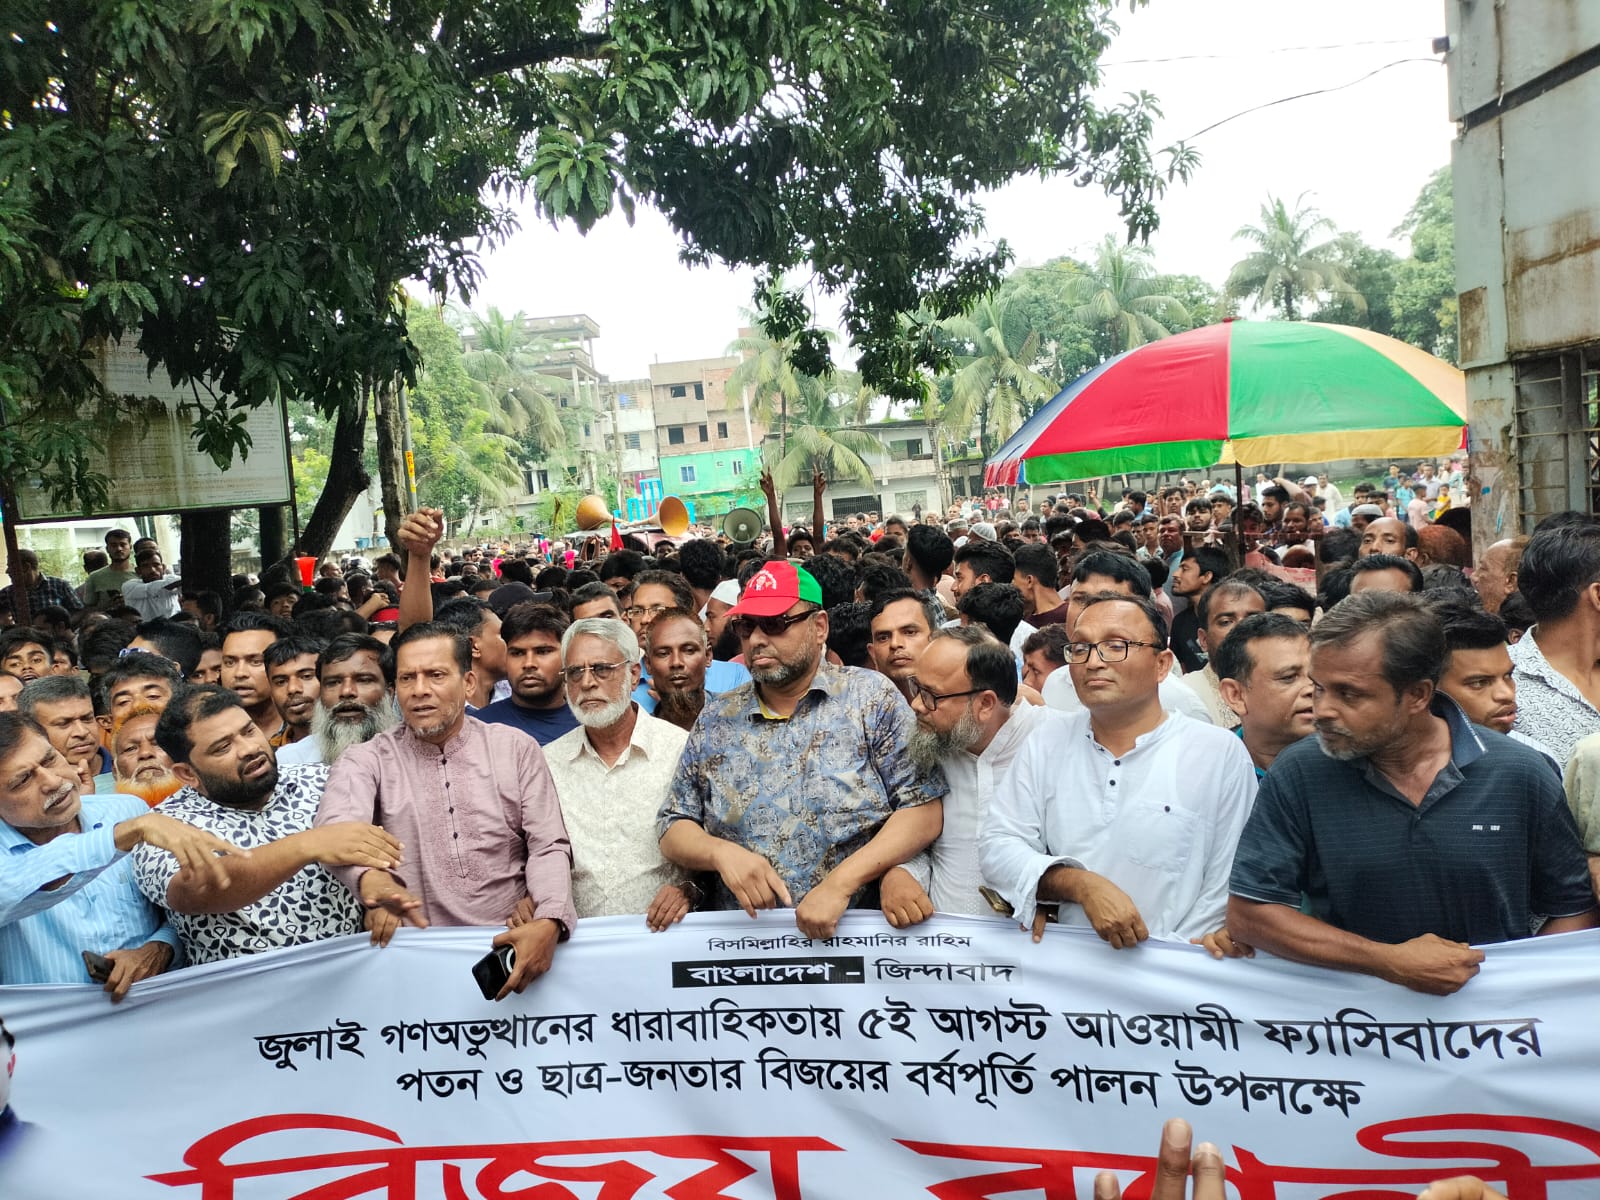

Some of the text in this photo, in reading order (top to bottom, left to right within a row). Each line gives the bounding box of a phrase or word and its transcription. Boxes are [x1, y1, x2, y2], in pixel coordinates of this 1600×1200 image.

[707, 933, 973, 951] বিসমিল্লাহির রাহমানির রাহিম
[686, 962, 836, 985] বাংলাদেশ
[872, 957, 1017, 982] জিন্দাবাদ
[253, 1018, 369, 1072] জুলাই
[610, 997, 845, 1043] ধারাবাহিকতায়
[858, 997, 917, 1042] ৫ই
[926, 998, 1052, 1043] আগস্ট
[1062, 1002, 1244, 1051] আওয়ামী
[1254, 1007, 1543, 1062] ফ্যাসিবাদের
[396, 1068, 484, 1102] পতন
[495, 1068, 524, 1095] ও
[754, 1046, 893, 1093] বিজয়ের
[900, 1048, 1037, 1110] বর্ষপূর্তি
[1050, 1064, 1161, 1108] পালন
[1172, 1059, 1366, 1118] উপলক্ষে
